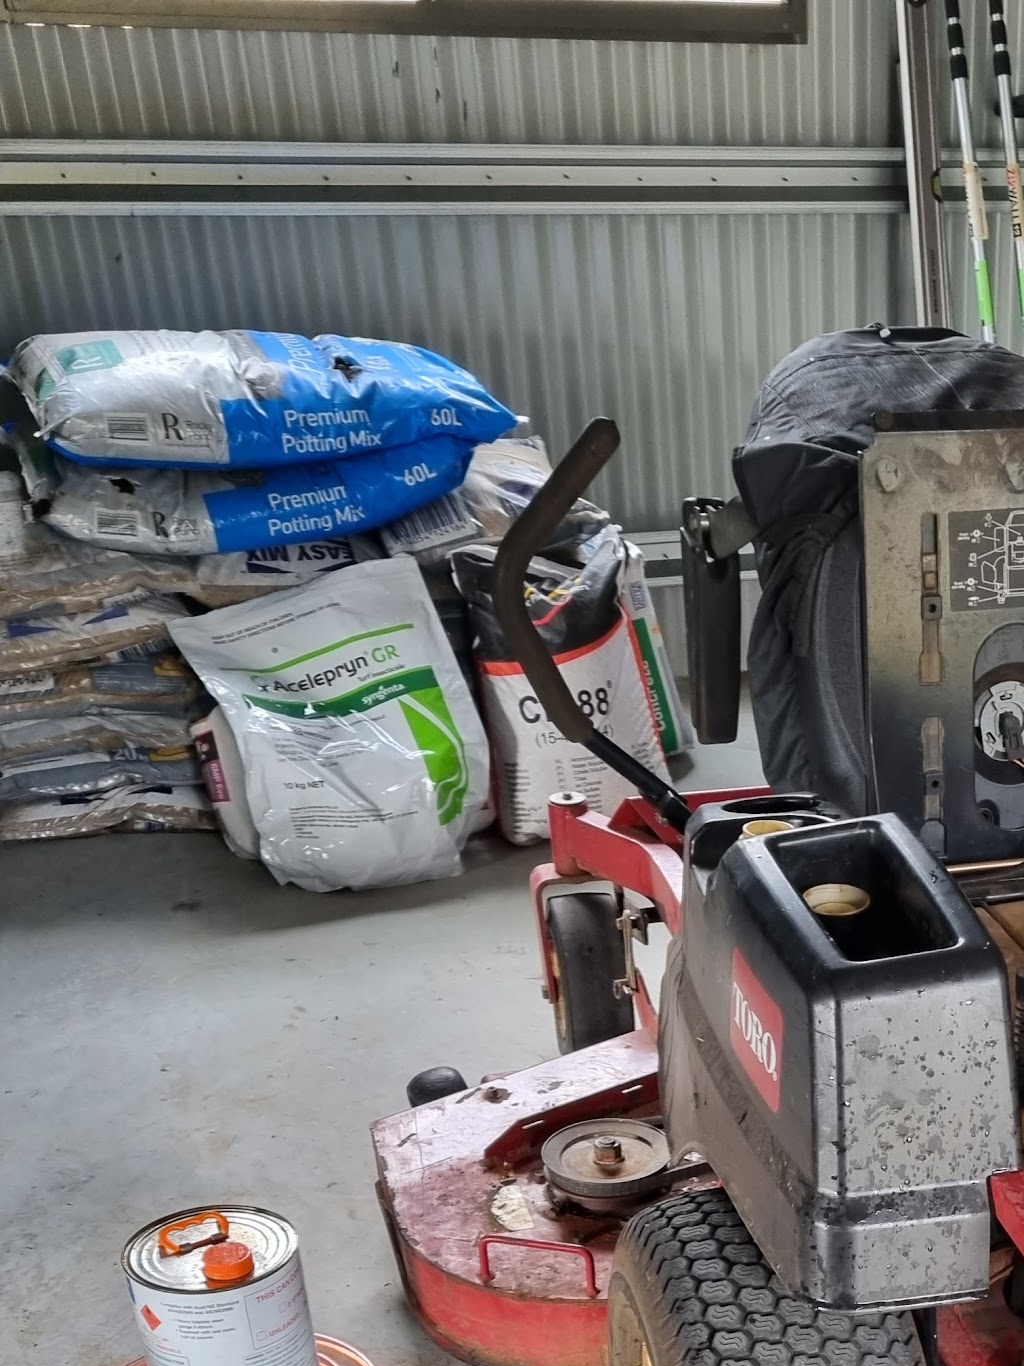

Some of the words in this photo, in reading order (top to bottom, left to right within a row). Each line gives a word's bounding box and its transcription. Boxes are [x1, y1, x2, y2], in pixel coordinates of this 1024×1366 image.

[161, 413, 184, 441] R
[284, 408, 370, 428] Premium
[430, 408, 462, 427] 60L
[282, 433, 347, 454] Potting
[350, 430, 382, 448] Mix
[403, 463, 437, 487] 60L
[267, 514, 333, 537] Potting
[335, 504, 366, 524] Mix
[246, 544, 290, 562] MIX
[297, 544, 354, 561] EASY
[273, 655, 368, 692] Acelepryn
[371, 644, 400, 664] GR
[283, 781, 293, 790] 10
[294, 781, 307, 791] kg
[307, 780, 325, 789] NET
[733, 982, 777, 1075] TORO
[255, 1290, 276, 1303] THIS
[276, 1279, 292, 1293] CAN
[269, 1312, 301, 1337] UNLEADED
